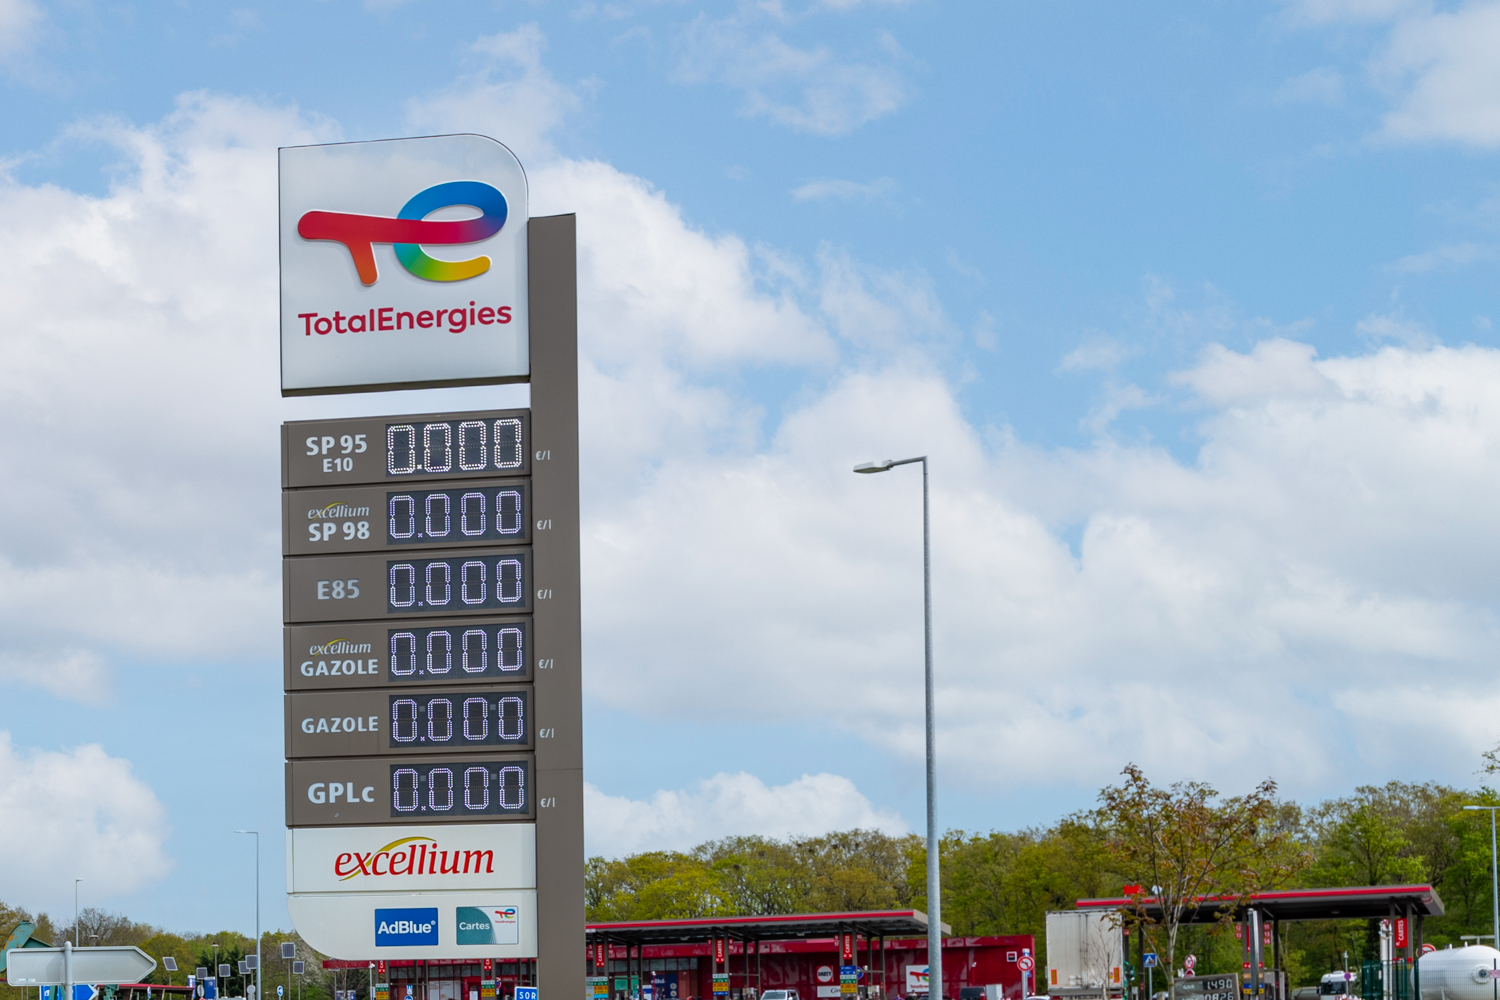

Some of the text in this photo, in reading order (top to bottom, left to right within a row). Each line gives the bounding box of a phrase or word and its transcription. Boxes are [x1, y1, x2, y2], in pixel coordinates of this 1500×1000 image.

[298, 301, 512, 336] TotalEnergies
[306, 434, 368, 456] SP 95
[322, 457, 353, 472] E10
[308, 502, 370, 520] excellium
[308, 521, 370, 542] SP 98
[317, 579, 360, 600] E85
[309, 639, 371, 657] excellium
[300, 659, 379, 677] GAZOLE
[301, 716, 379, 734] GAZOLE
[307, 782, 375, 804] GPLc
[334, 841, 494, 878] excellium
[459, 921, 490, 931] Cartes
